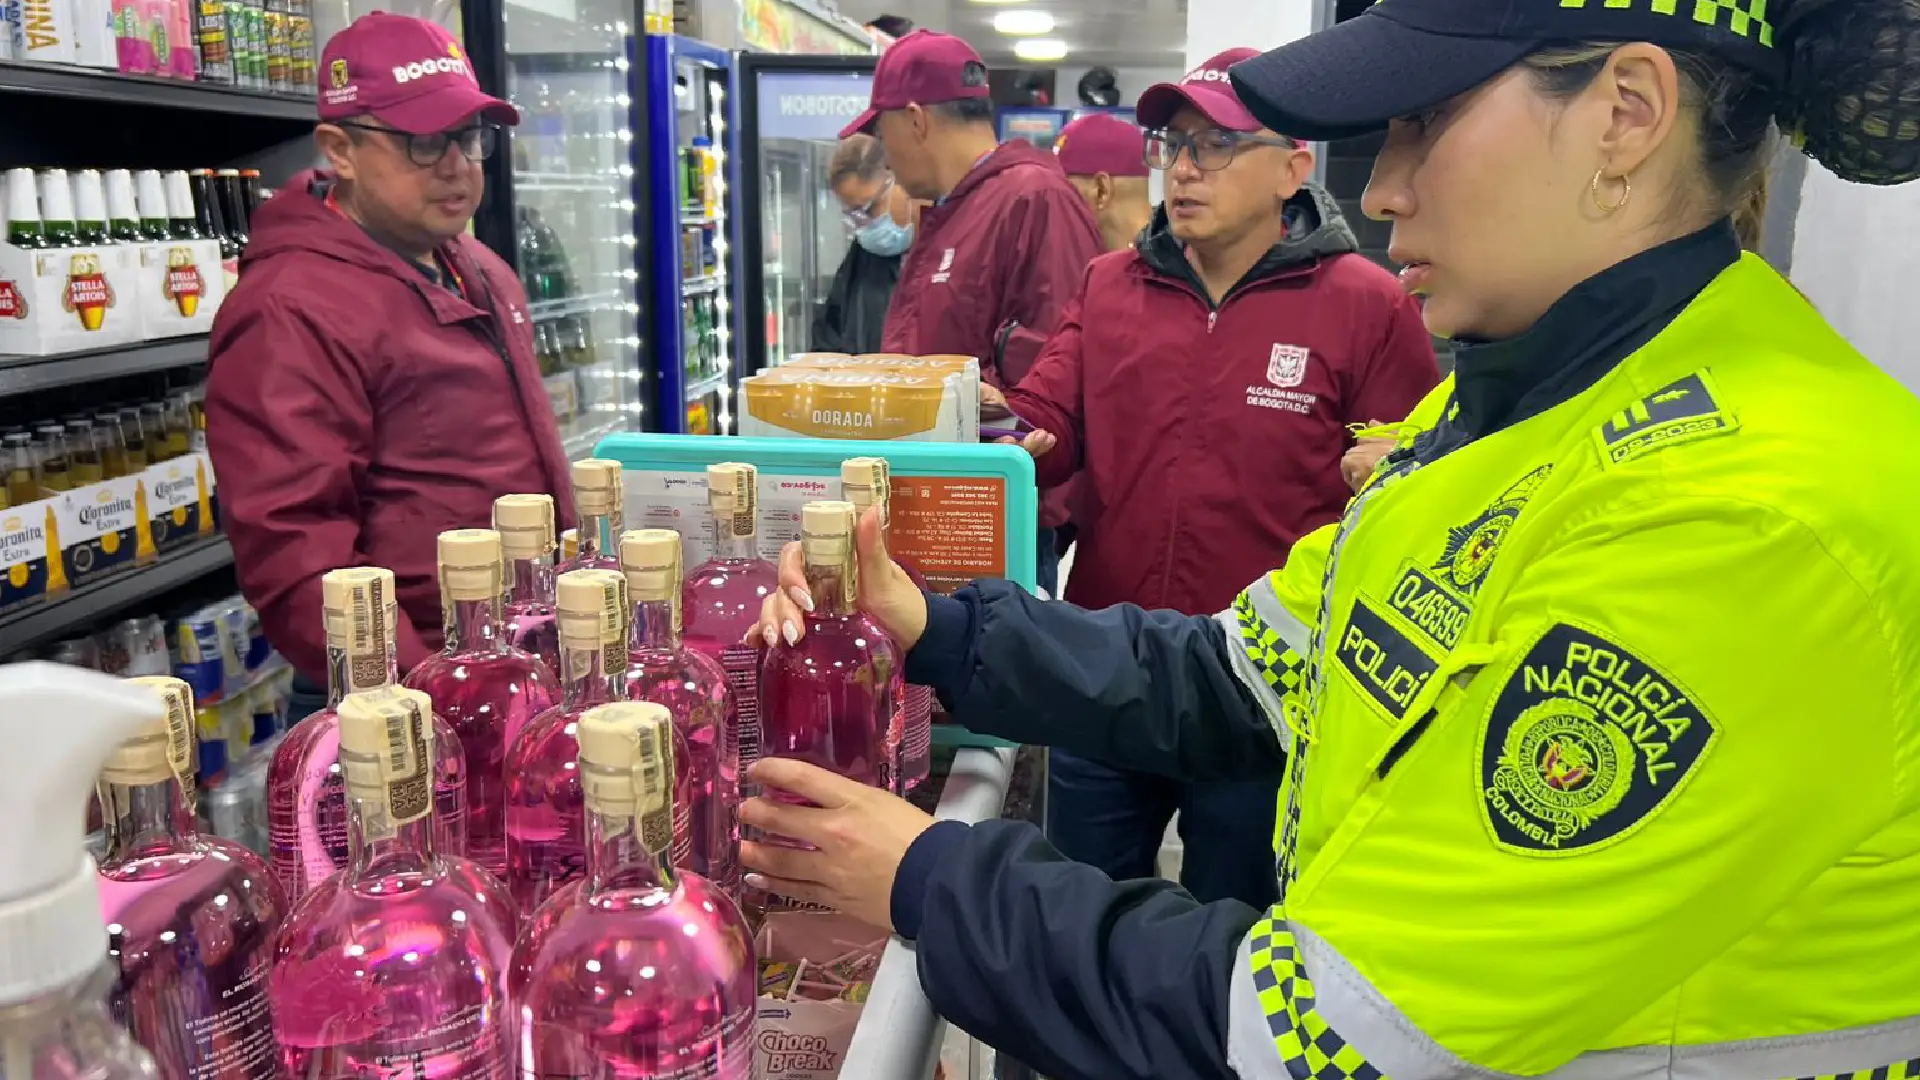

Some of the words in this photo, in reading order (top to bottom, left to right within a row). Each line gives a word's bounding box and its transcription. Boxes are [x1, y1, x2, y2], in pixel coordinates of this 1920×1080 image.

[71, 279, 105, 292] STELLA
[170, 270, 198, 282] STELLA
[171, 281, 200, 292] ARTOIS
[72, 290, 107, 303] ARTOIS
[813, 410, 873, 428] DORADA
[155, 475, 195, 497] Coronita
[79, 498, 132, 525] Coronita
[96, 518, 121, 531] Extra
[0, 525, 43, 547] oronita
[3, 548, 30, 562] Extra
[1566, 640, 1692, 744] POLICÍA
[1524, 664, 1677, 785] NACIONAL
[1486, 786, 1559, 849] COLOMBIA
[758, 1029, 828, 1057] Choco
[767, 1048, 838, 1074] Break
